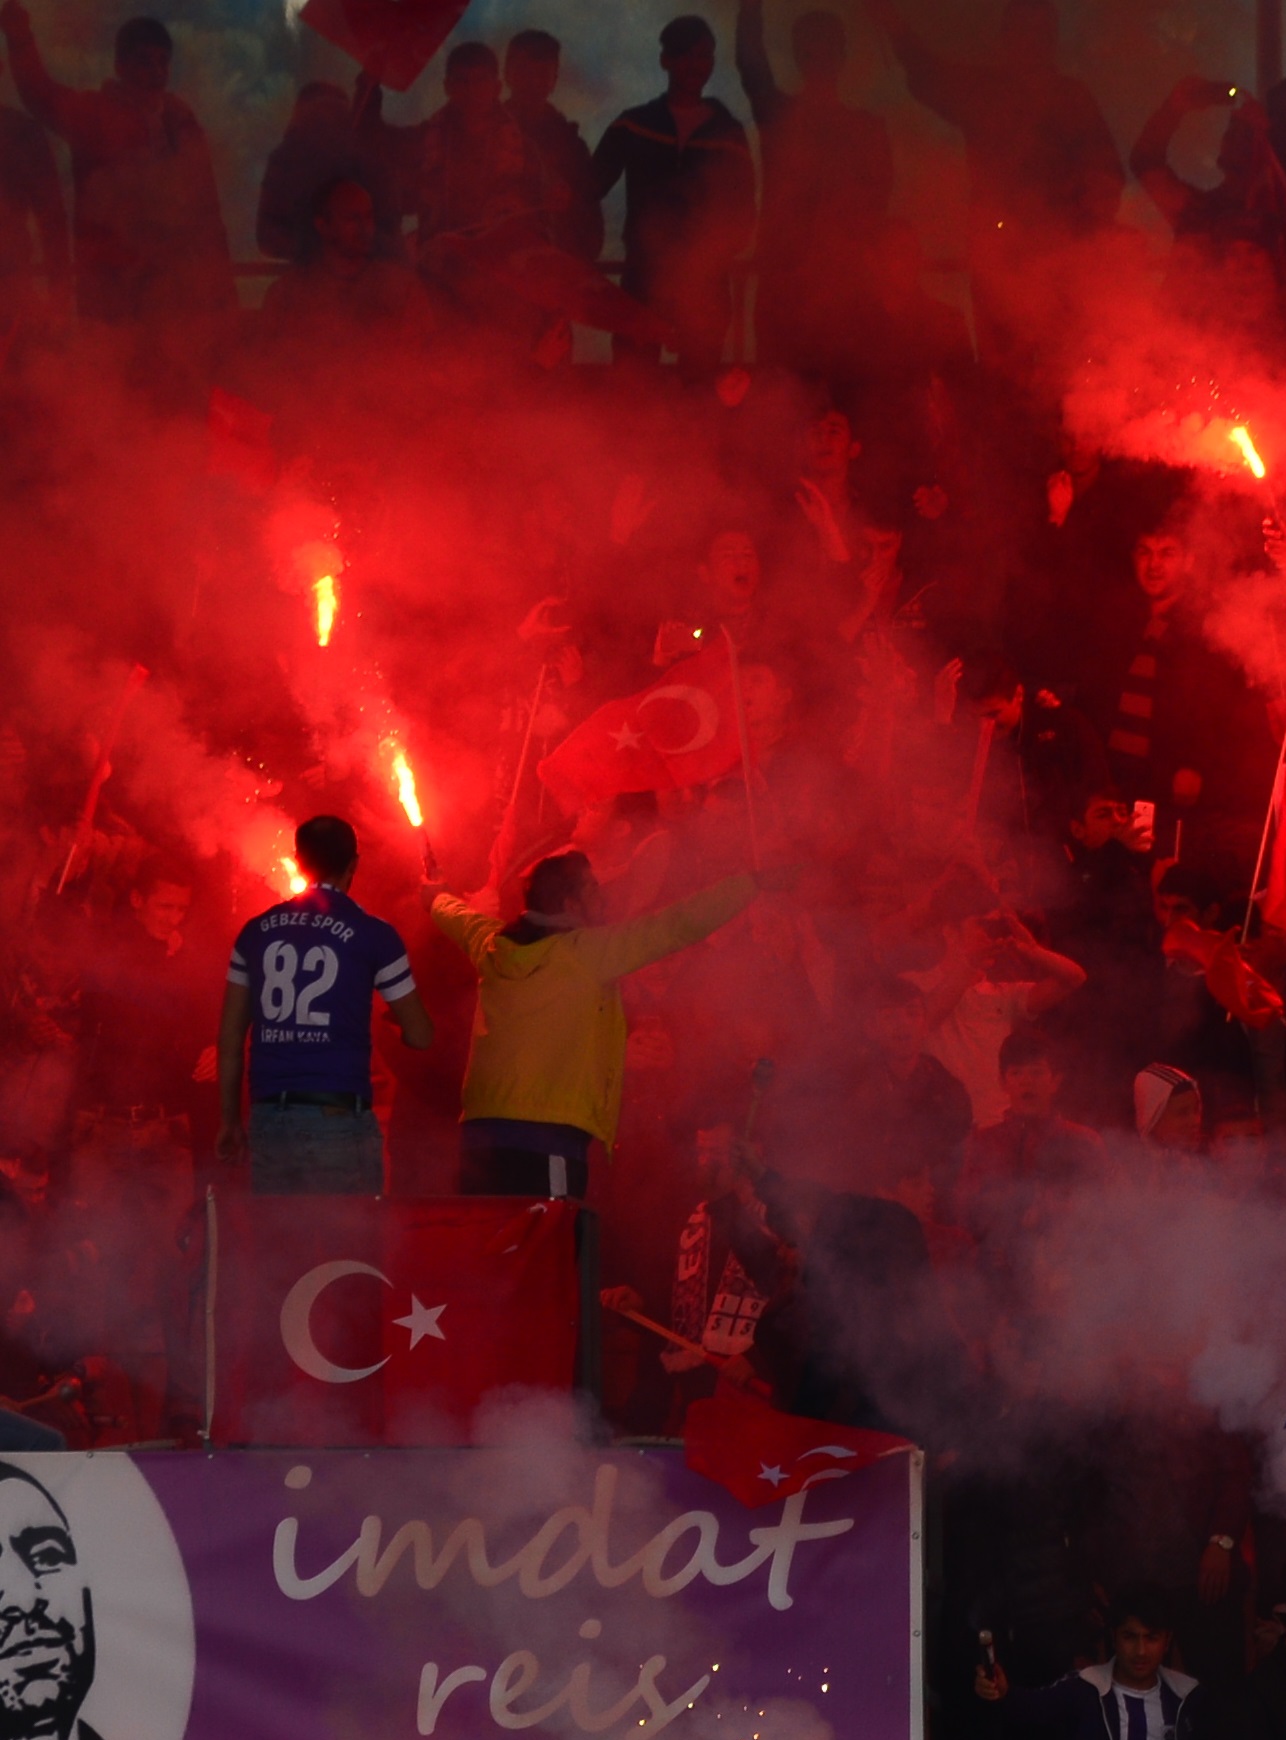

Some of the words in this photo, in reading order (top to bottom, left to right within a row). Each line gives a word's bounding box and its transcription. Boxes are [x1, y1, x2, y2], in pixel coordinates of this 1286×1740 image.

[260, 911, 310, 932] GEBZE
[311, 914, 355, 943] SPOR
[259, 939, 339, 1027] 82
[271, 1463, 856, 1611] imdat
